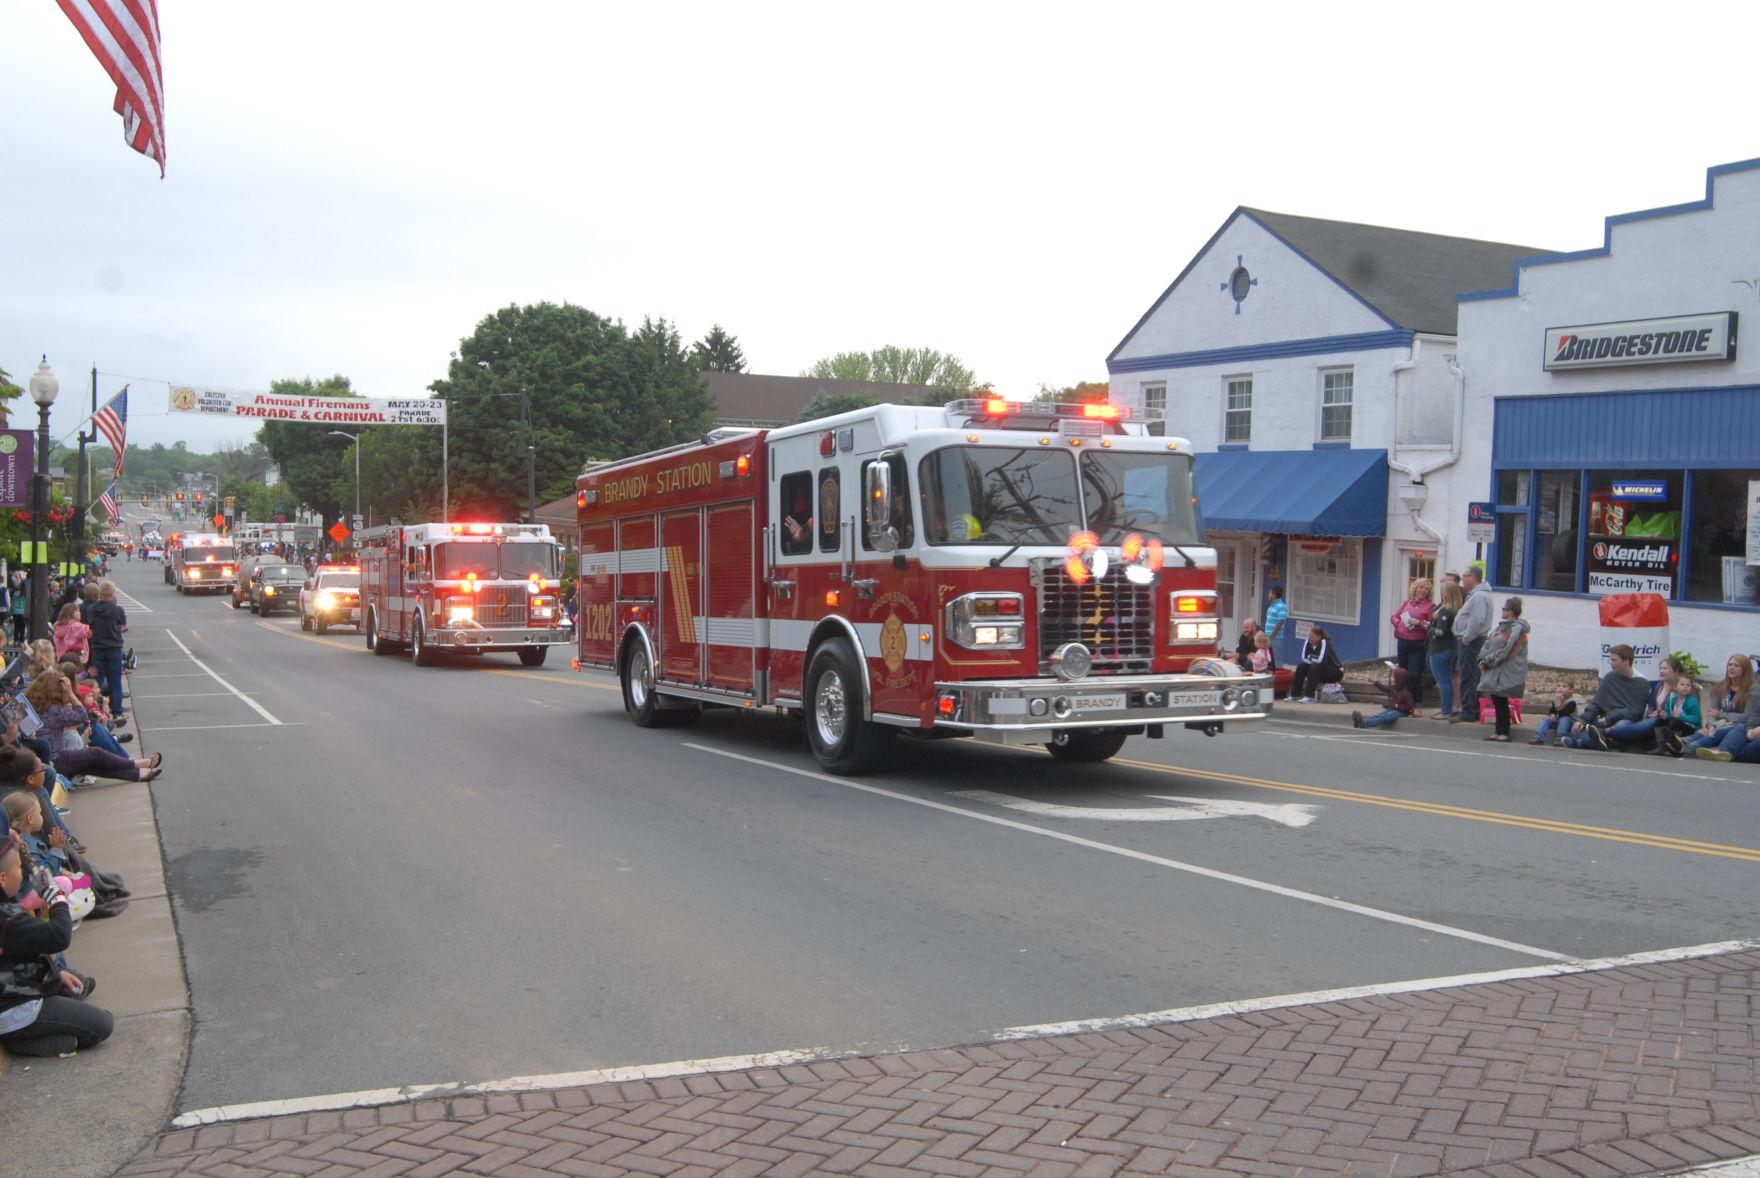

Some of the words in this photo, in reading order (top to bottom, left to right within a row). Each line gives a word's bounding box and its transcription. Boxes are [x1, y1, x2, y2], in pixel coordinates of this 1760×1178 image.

[1554, 328, 1713, 361] BRIDGESTONE
[254, 395, 305, 407] Annual
[308, 398, 371, 410] Firemans
[387, 400, 411, 409] MAY
[236, 405, 297, 419] PARADE
[300, 410, 311, 421] &
[313, 411, 386, 422] CARNIVAL
[4, 454, 16, 502] downtown
[604, 474, 649, 504] BRANDY
[656, 461, 712, 495] STATION
[1624, 486, 1663, 494] MICHELIN
[1607, 544, 1669, 562] Kendall
[1606, 560, 1640, 568] MOTOR
[1647, 561, 1665, 569] OIL
[1589, 575, 1643, 592] McCarthy
[1646, 579, 1670, 592] Tire
[585, 603, 612, 641] 1202
[890, 635, 896, 650] 2
[1075, 697, 1122, 709] BRANDY
[1173, 693, 1217, 705] STATION
